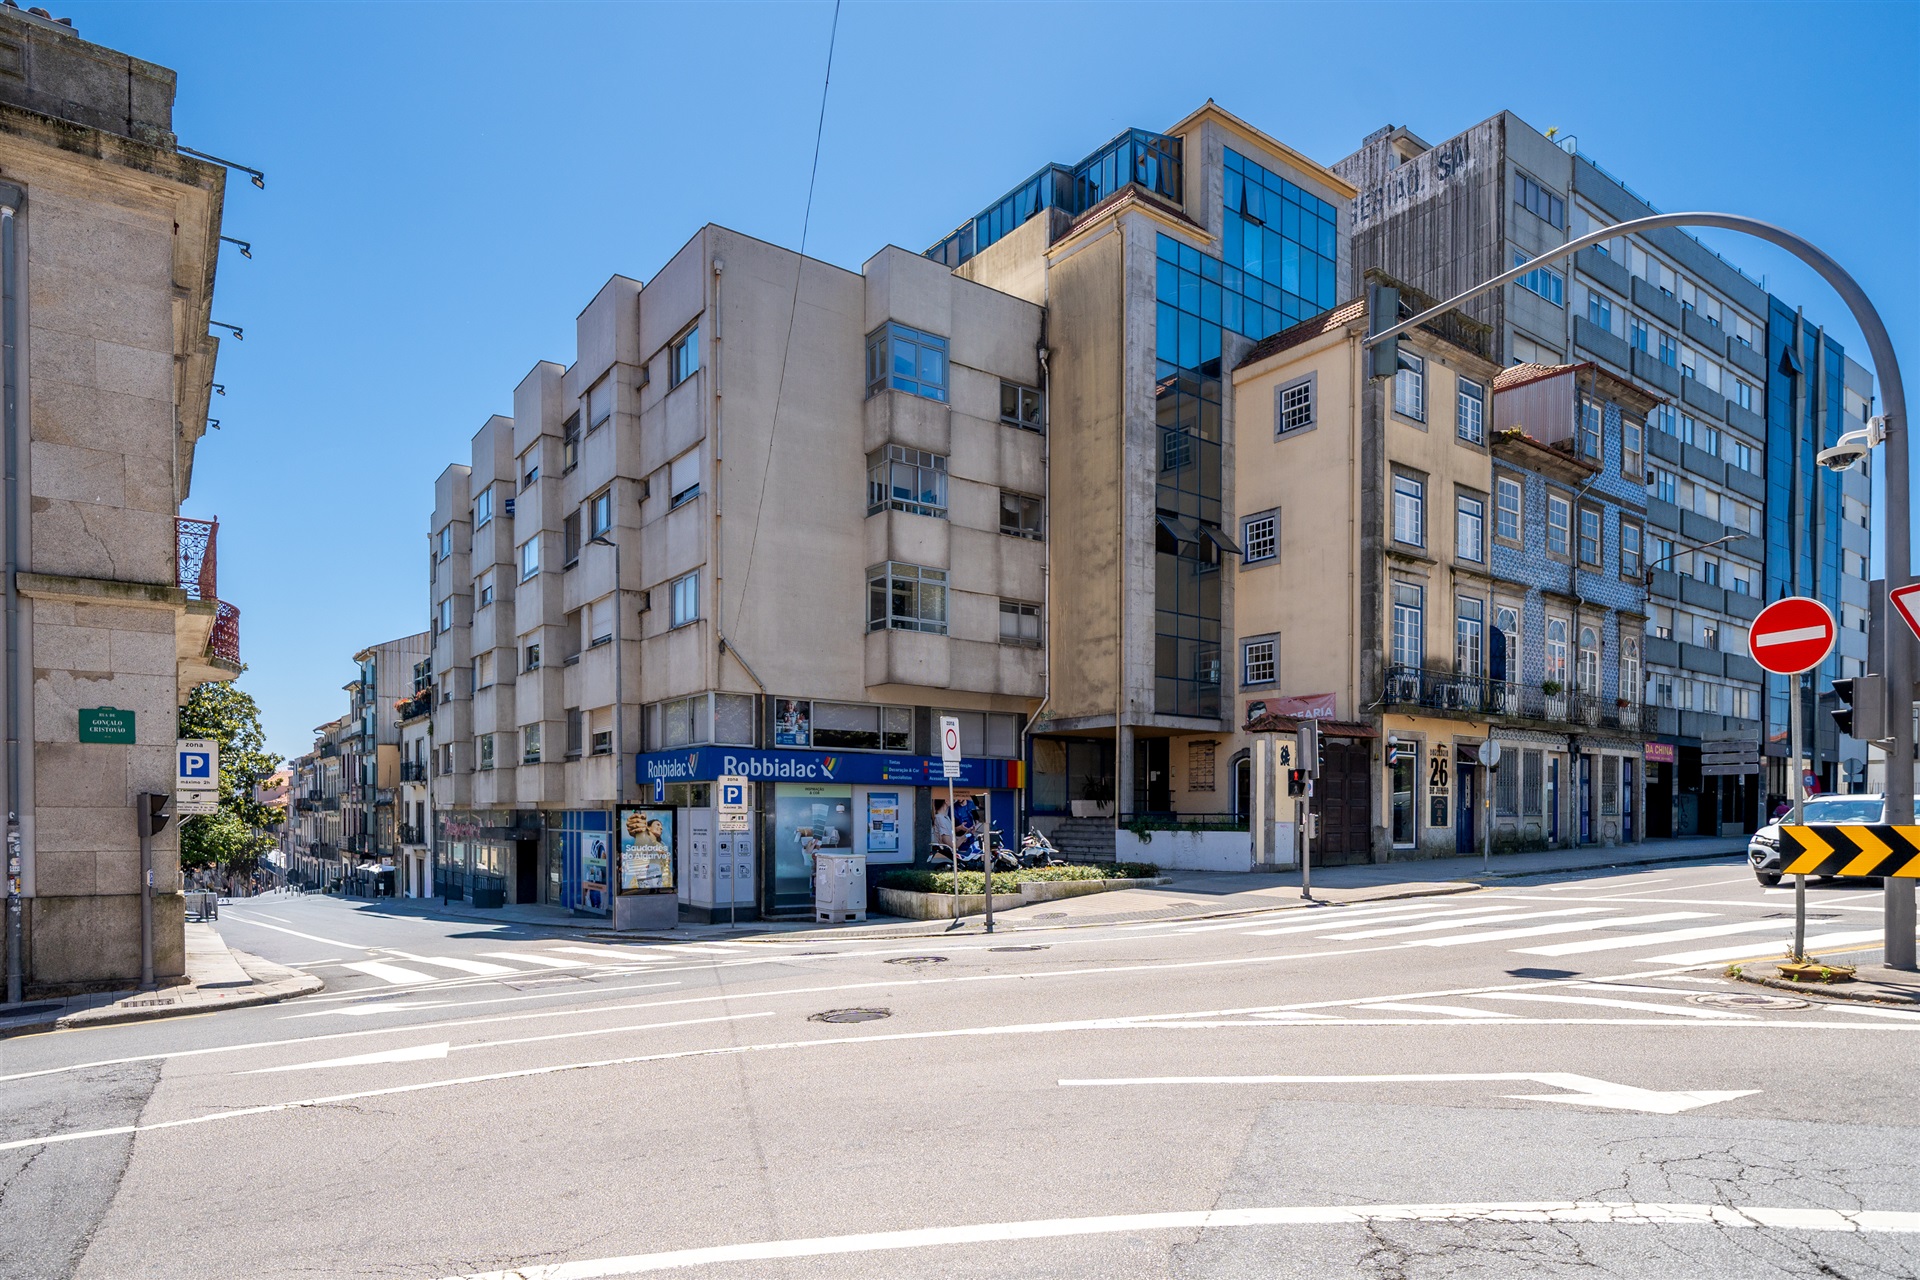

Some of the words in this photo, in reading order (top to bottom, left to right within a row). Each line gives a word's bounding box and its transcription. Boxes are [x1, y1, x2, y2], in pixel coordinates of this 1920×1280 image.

[1645, 744, 1653, 754] DA
[1655, 745, 1673, 756] CHINA
[186, 755, 204, 776] P
[647, 759, 687, 778] Robbialac
[724, 755, 817, 778] Robbialac
[1429, 757, 1448, 787] 26
[656, 778, 662, 799] P
[727, 787, 739, 803] P
[625, 844, 668, 852] Saudades
[635, 852, 671, 861] Algarve?
